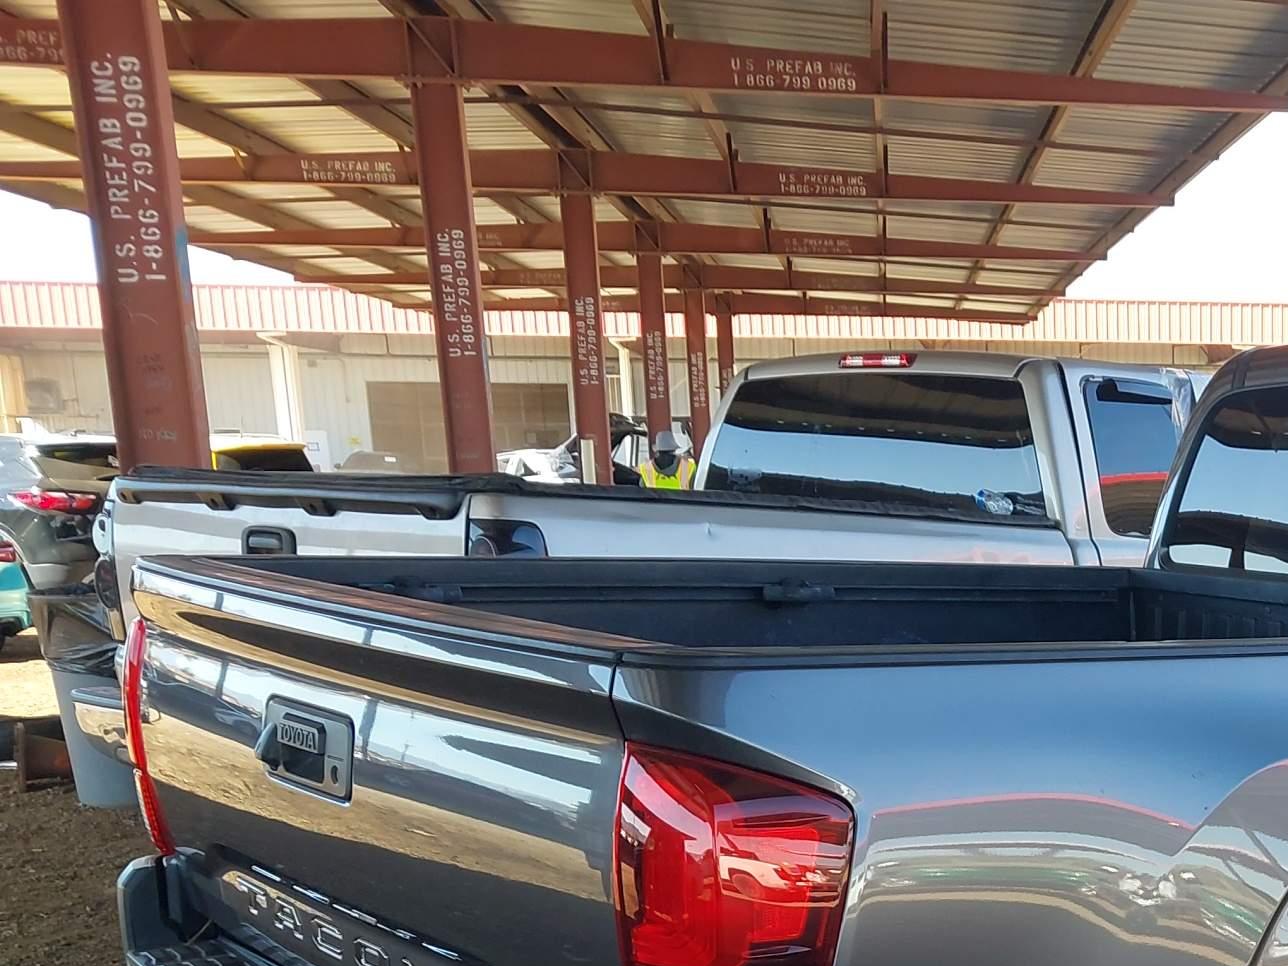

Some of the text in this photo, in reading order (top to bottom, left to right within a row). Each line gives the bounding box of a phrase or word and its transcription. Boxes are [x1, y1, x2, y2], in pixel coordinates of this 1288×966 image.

[16, 29, 59, 45] PREF
[767, 58, 823, 75] PREFAB
[91, 52, 139, 283] U.S. PREFAB INC.
[117, 55, 167, 281] 1-866-799-0969
[374, 161, 397, 172] INC.
[437, 228, 462, 357] U.S. PREFAB INC.
[451, 229, 477, 356] 1-866-799-0969
[278, 722, 315, 751] TOYOTA
